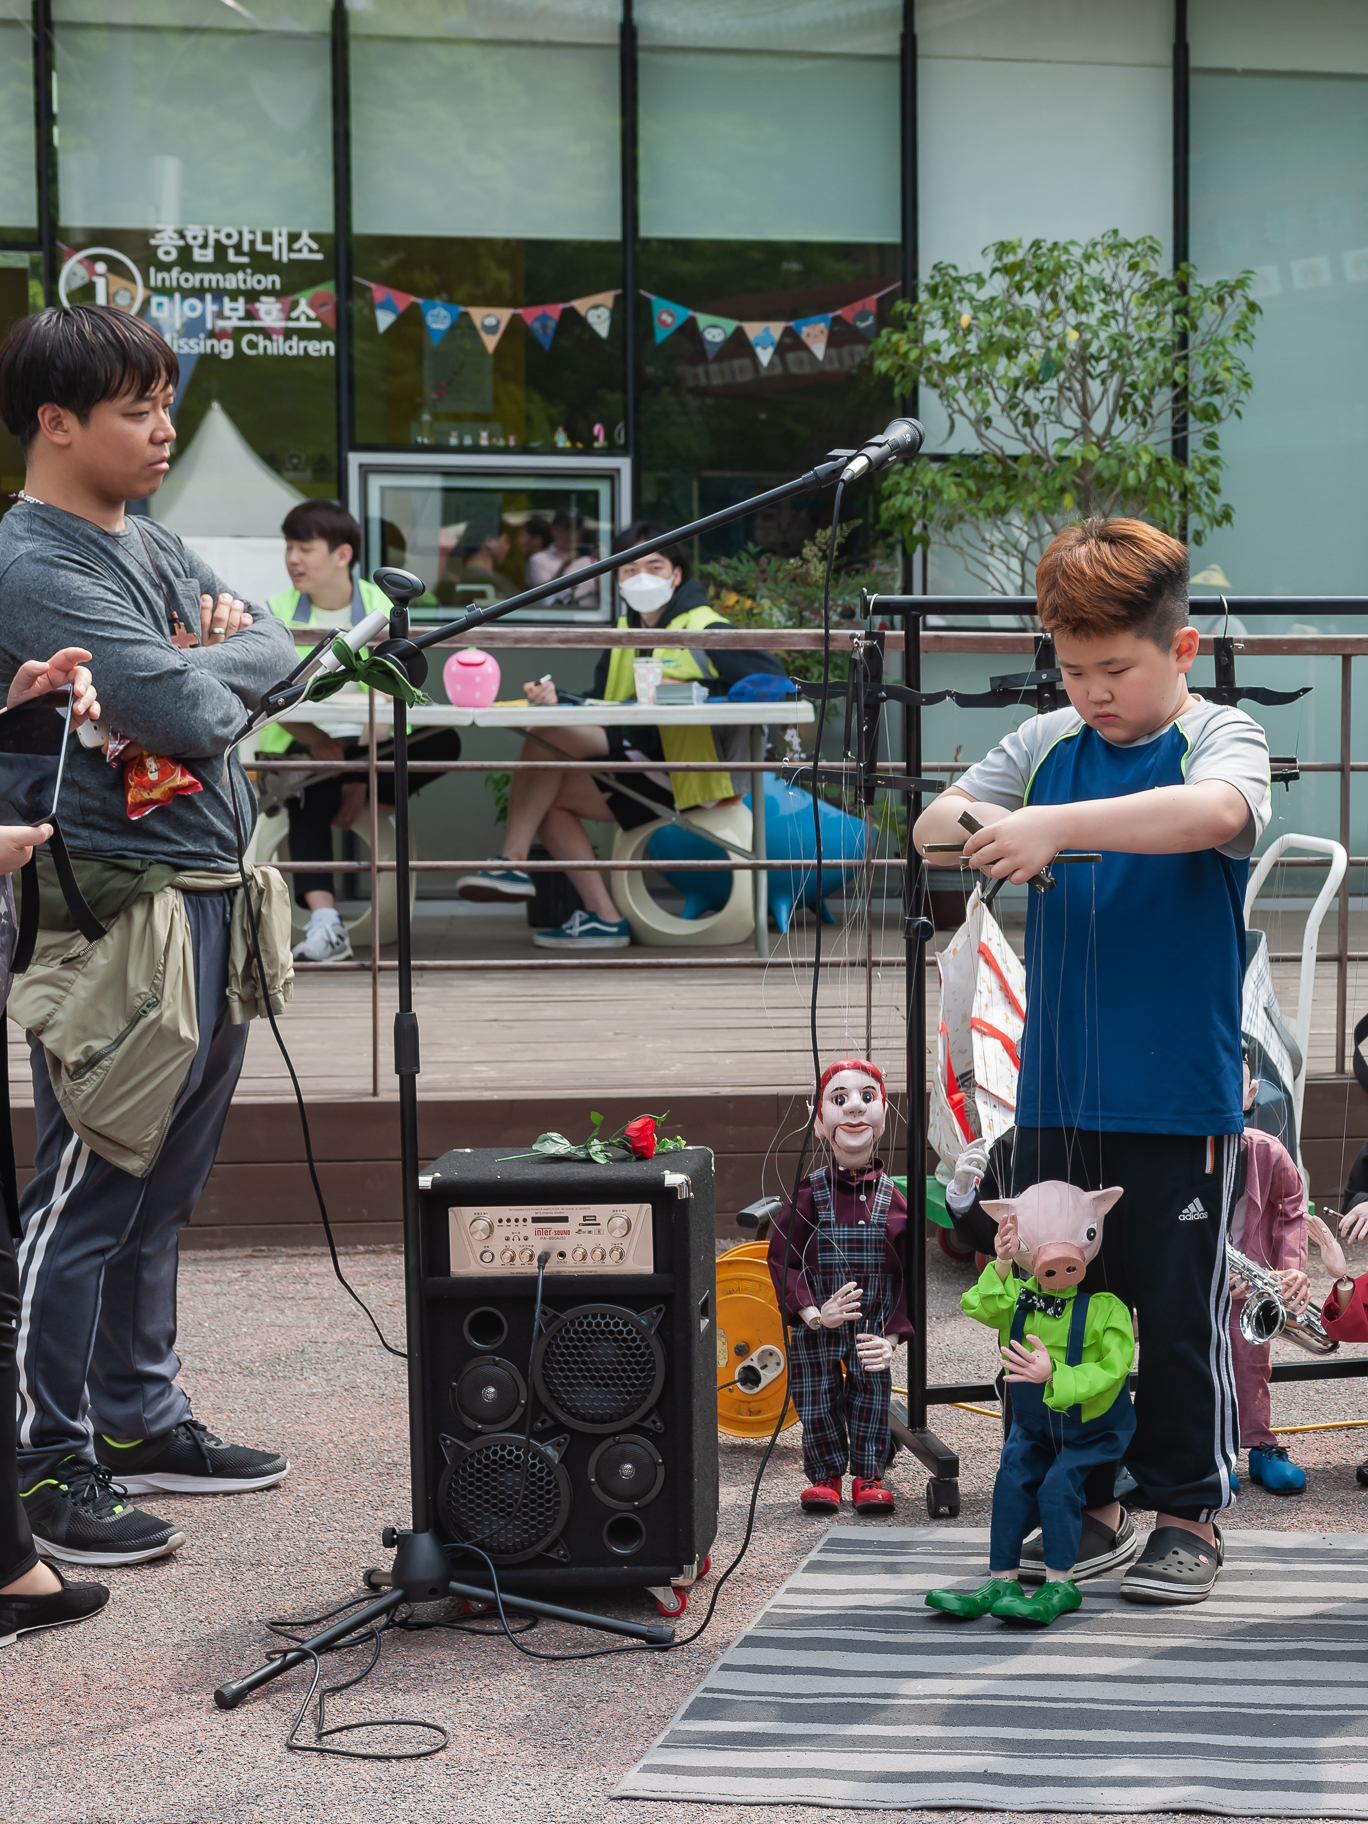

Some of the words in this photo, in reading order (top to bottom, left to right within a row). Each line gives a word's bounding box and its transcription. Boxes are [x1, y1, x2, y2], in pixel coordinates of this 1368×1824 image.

[150, 224, 324, 263] 종합안내소
[150, 266, 281, 291] Information
[150, 293, 322, 330] 미아보호소
[241, 333, 335, 357] Children
[1178, 1211, 1208, 1221] adidas
